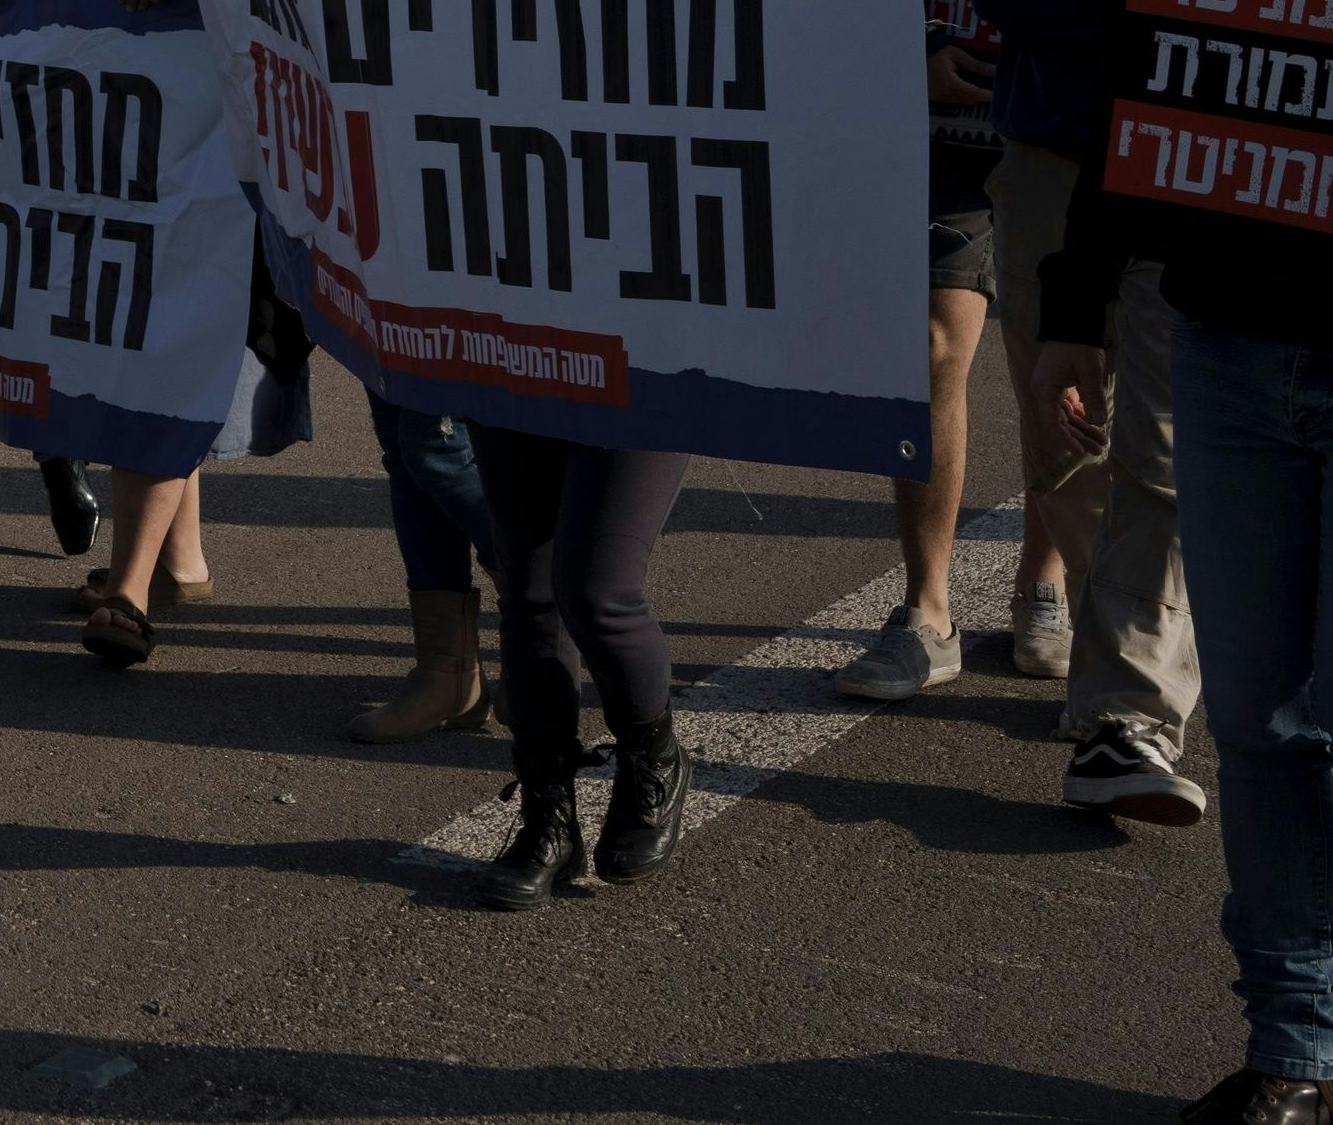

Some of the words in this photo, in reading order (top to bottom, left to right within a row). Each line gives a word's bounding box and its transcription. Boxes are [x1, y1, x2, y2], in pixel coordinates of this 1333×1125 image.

[1117, 119, 1333, 219] ומניטרי
[414, 114, 776, 310] הביתה
[379, 320, 456, 361] להחזרת
[460, 329, 559, 381] המשפחות
[2, 373, 35, 405] מטה
[559, 349, 606, 389] מטה
